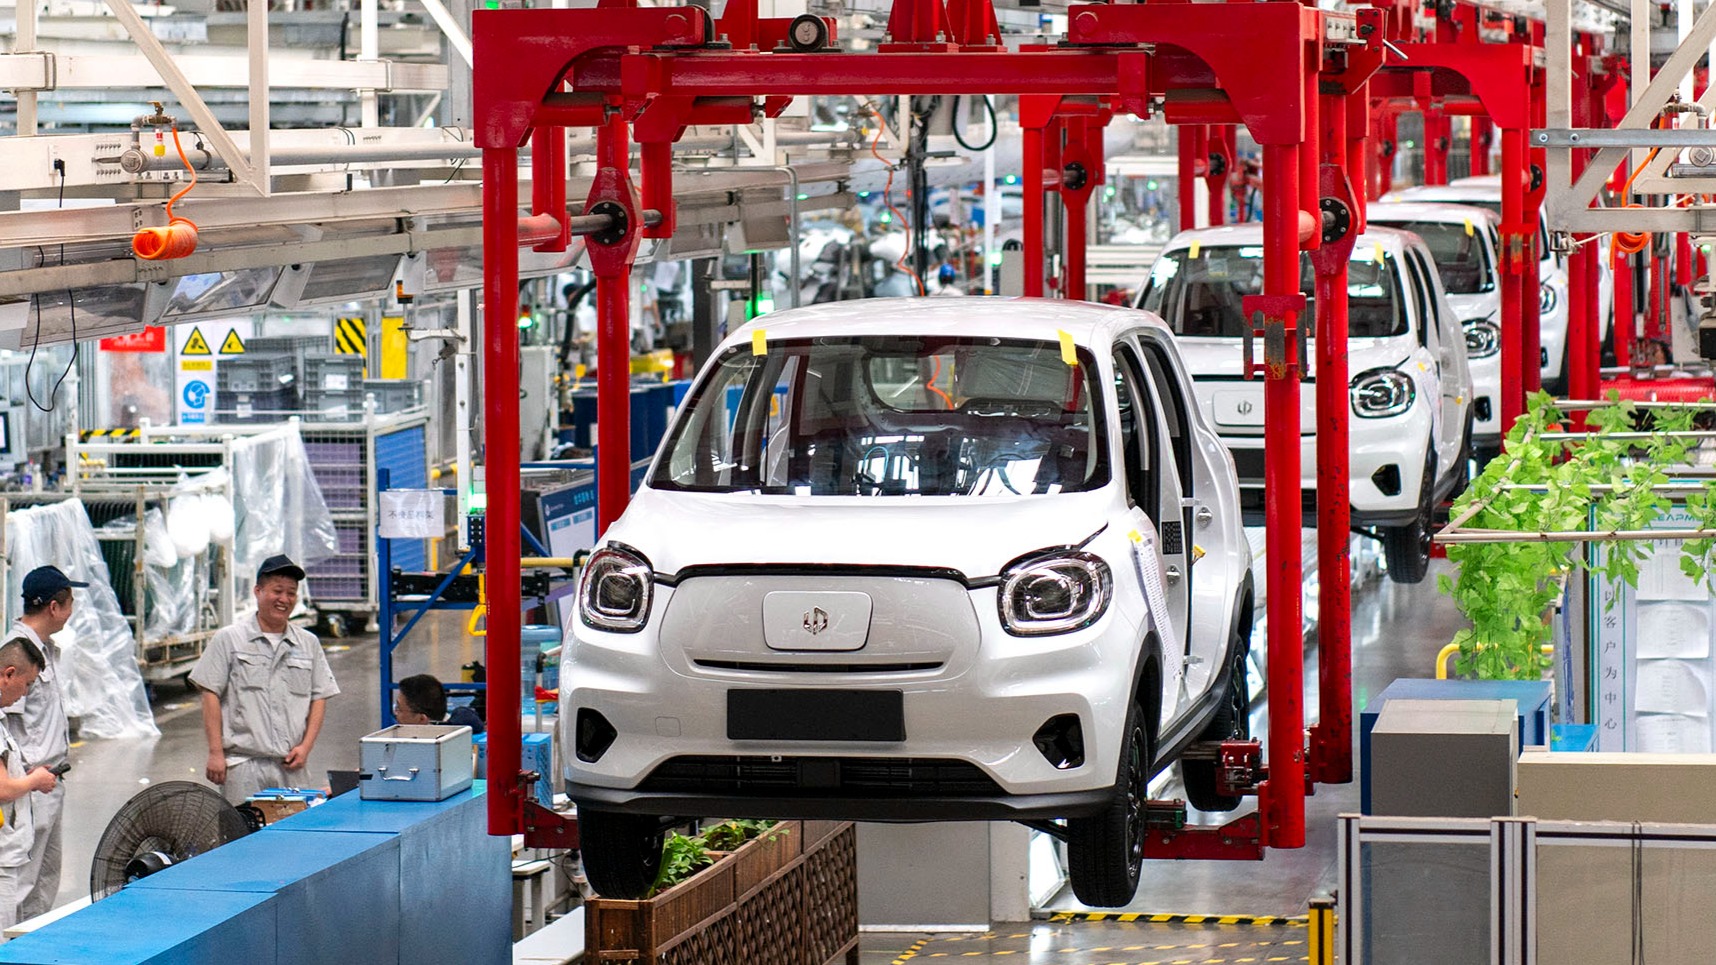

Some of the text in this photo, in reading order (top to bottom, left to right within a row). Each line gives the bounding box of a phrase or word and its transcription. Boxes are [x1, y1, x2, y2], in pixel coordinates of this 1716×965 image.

[1652, 513, 1703, 523] EAPM
[1603, 589, 1618, 731] 以客户为中心
